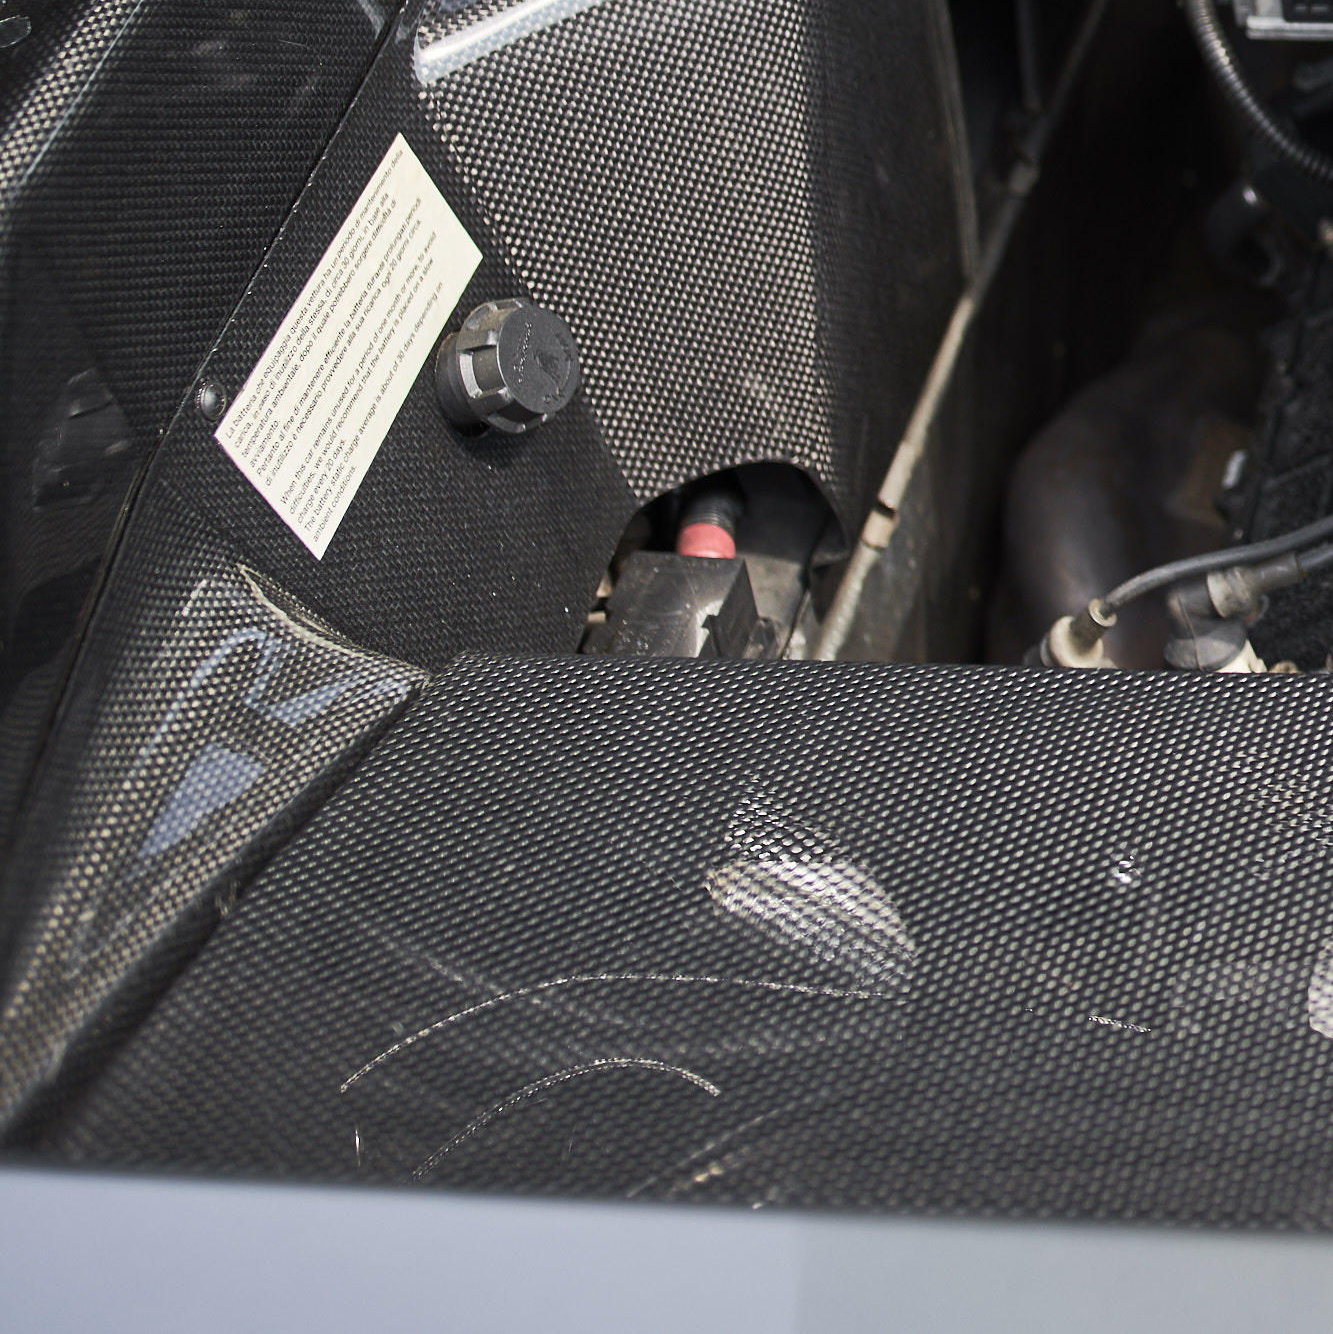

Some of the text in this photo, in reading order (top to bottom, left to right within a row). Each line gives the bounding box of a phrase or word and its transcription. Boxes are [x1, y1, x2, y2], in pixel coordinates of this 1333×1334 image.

[225, 149, 403, 439] La batteria che equipaggia questa vettura ha un periodo di mantenimento della
[234, 192, 389, 448] carica, in caso di inutilizzo della stessa, di circa 30 giorni, in base alla
[241, 407, 273, 457] temperatura
[271, 363, 301, 408] ambientale,
[298, 339, 313, 362] dopo
[310, 331, 317, 340] il
[315, 311, 330, 334] quale
[328, 269, 355, 313] potrebbero
[353, 239, 372, 270] sorgere
[390, 198, 396, 208] di
[256, 197, 421, 477] Pertanto al fine di mantenere efficiente la batteria durante prolungati periodi
[265, 476, 272, 486] di
[271, 440, 293, 476] inutilizzo
[295, 389, 322, 433] necessario
[320, 345, 347, 392] provvedere
[346, 330, 356, 346] alla
[354, 315, 365, 331] sua
[363, 287, 381, 316] ricarica
[381, 269, 391, 288] ogni
[388, 258, 397, 271] 20
[395, 237, 409, 261] giorni
[279, 479, 297, 504] When
[294, 463, 306, 480] this
[304, 448, 313, 464] car
[312, 416, 332, 449] remains
[330, 385, 349, 417] unused
[346, 373, 355, 387] for
[358, 340, 374, 370] period
[372, 331, 378, 343] of
[377, 317, 387, 334] one
[386, 293, 401, 318] month
[400, 283, 406, 293] or
[405, 264, 419, 284] more,
[417, 253, 424, 262] to
[423, 230, 436, 253] avoid
[289, 471, 316, 514] difficulties,
[313, 456, 323, 469] we
[321, 429, 337, 455] would
[335, 382, 363, 431] recommend
[360, 366, 372, 384] that
[369, 353, 379, 368] the
[377, 326, 395, 354] battery
[393, 318, 399, 327] is
[397, 290, 413, 320] placed
[412, 281, 420, 293] on
[422, 257, 433, 276] slow
[303, 281, 442, 531] The battery static charge average is about of 30 days depending on
[249, 419, 280, 468] avviamento.
[297, 438, 346, 523] charge every 20 days.
[313, 465, 356, 542] ambient conditions.
